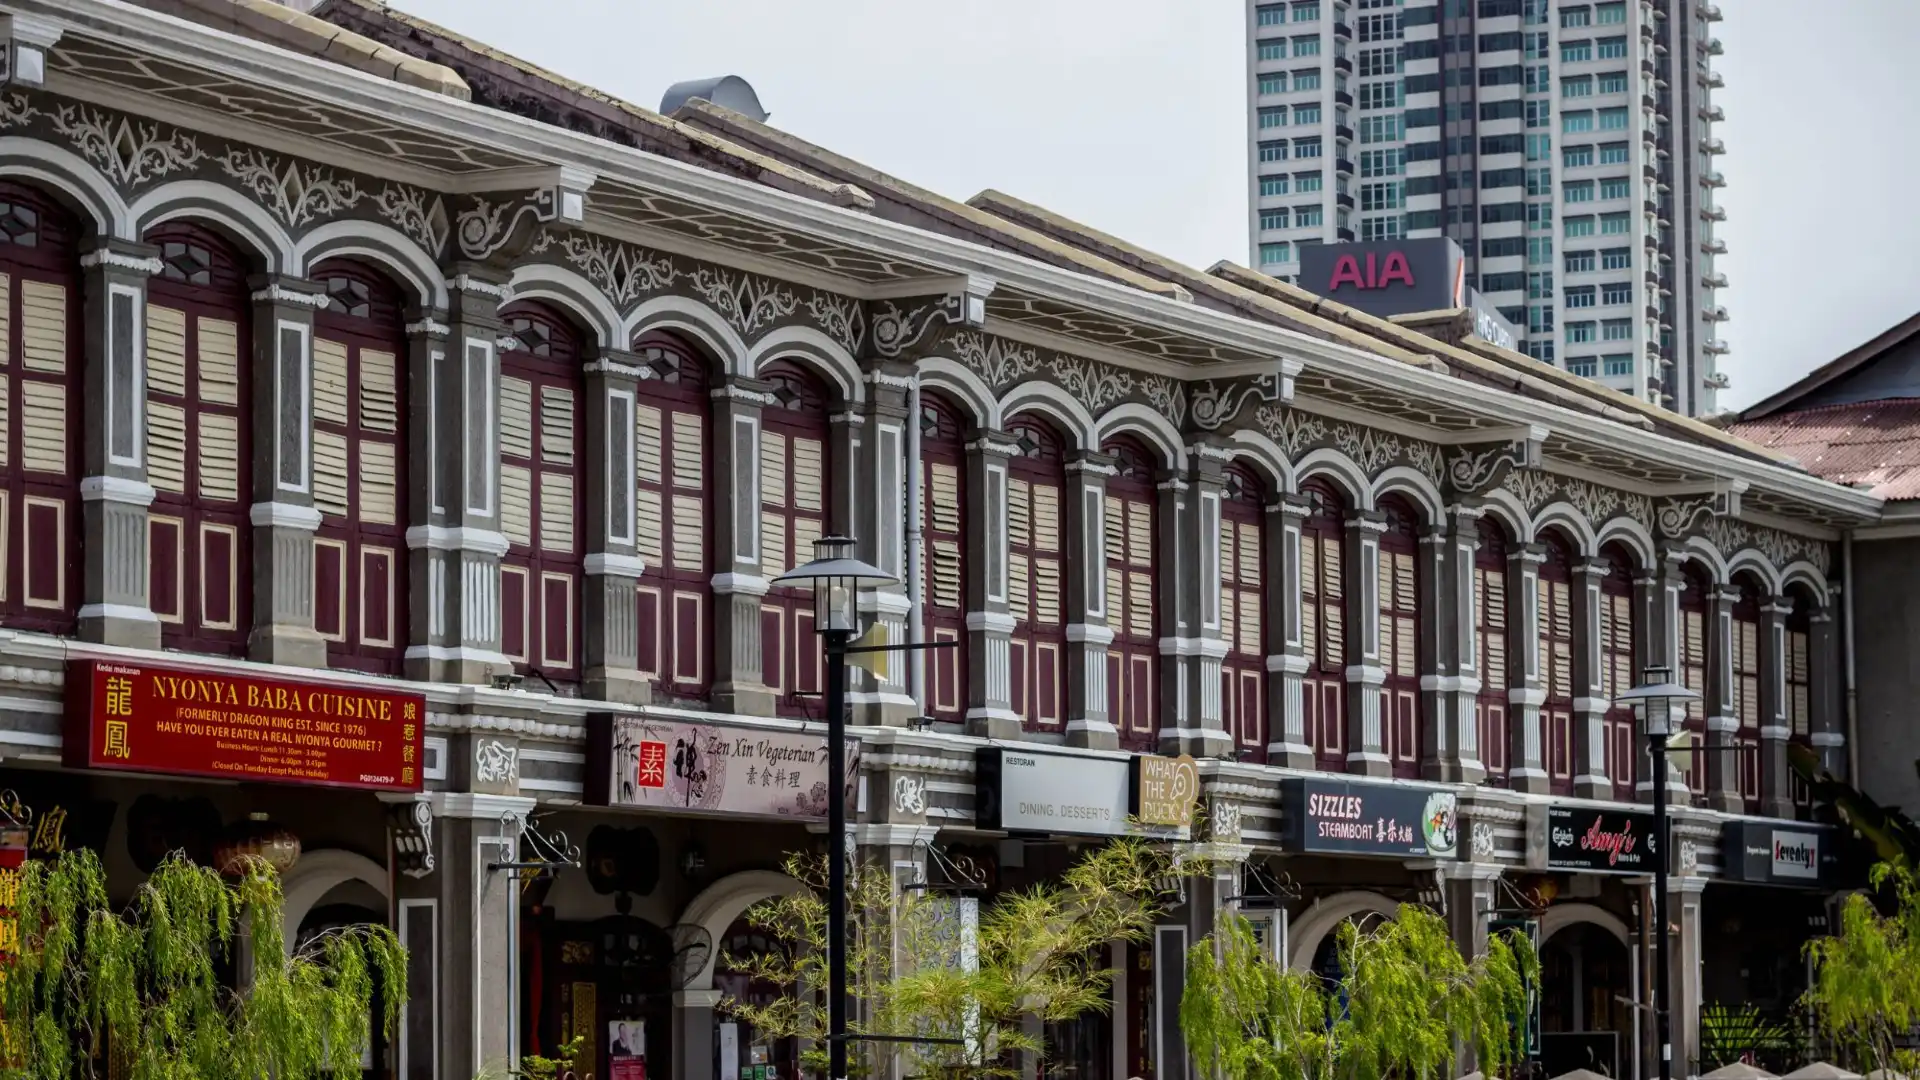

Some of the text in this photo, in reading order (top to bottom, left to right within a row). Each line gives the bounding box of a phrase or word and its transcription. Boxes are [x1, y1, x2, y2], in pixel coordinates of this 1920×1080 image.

[1329, 250, 1415, 291] AIA
[96, 663, 141, 676] Kedai makanan
[152, 675, 392, 721] NYONYA BABA CUISINE
[103, 676, 132, 758] 龍鳳
[176, 707, 367, 736] (FORMERLY DRAGON KING EST. SINCE 1976)
[156, 720, 182, 733] HAVE
[184, 723, 204, 735] YOU
[206, 725, 229, 738] EVER
[231, 727, 260, 740] EATEN
[262, 731, 269, 741] A
[270, 731, 293, 744] REAL
[295, 734, 331, 747] NYONYA
[332, 737, 376, 751] GOURMET
[216, 741, 240, 750] Business
[640, 745, 664, 783] 素
[706, 736, 730, 755] Zen
[731, 738, 754, 758] Xin
[757, 740, 816, 767] Vegeterian
[1006, 757, 1035, 767] RESTORAN
[745, 765, 801, 789] 素食料理
[1145, 760, 1177, 780] WHAT
[1145, 780, 1165, 800] THE
[1019, 802, 1054, 817] DINING
[1061, 804, 1111, 821] DESSERTS
[1144, 801, 1180, 821] DUCK
[1308, 793, 1362, 820] SIZZLES
[1318, 821, 1373, 840] STEAMBOAT
[1581, 815, 1636, 866] Amy's
